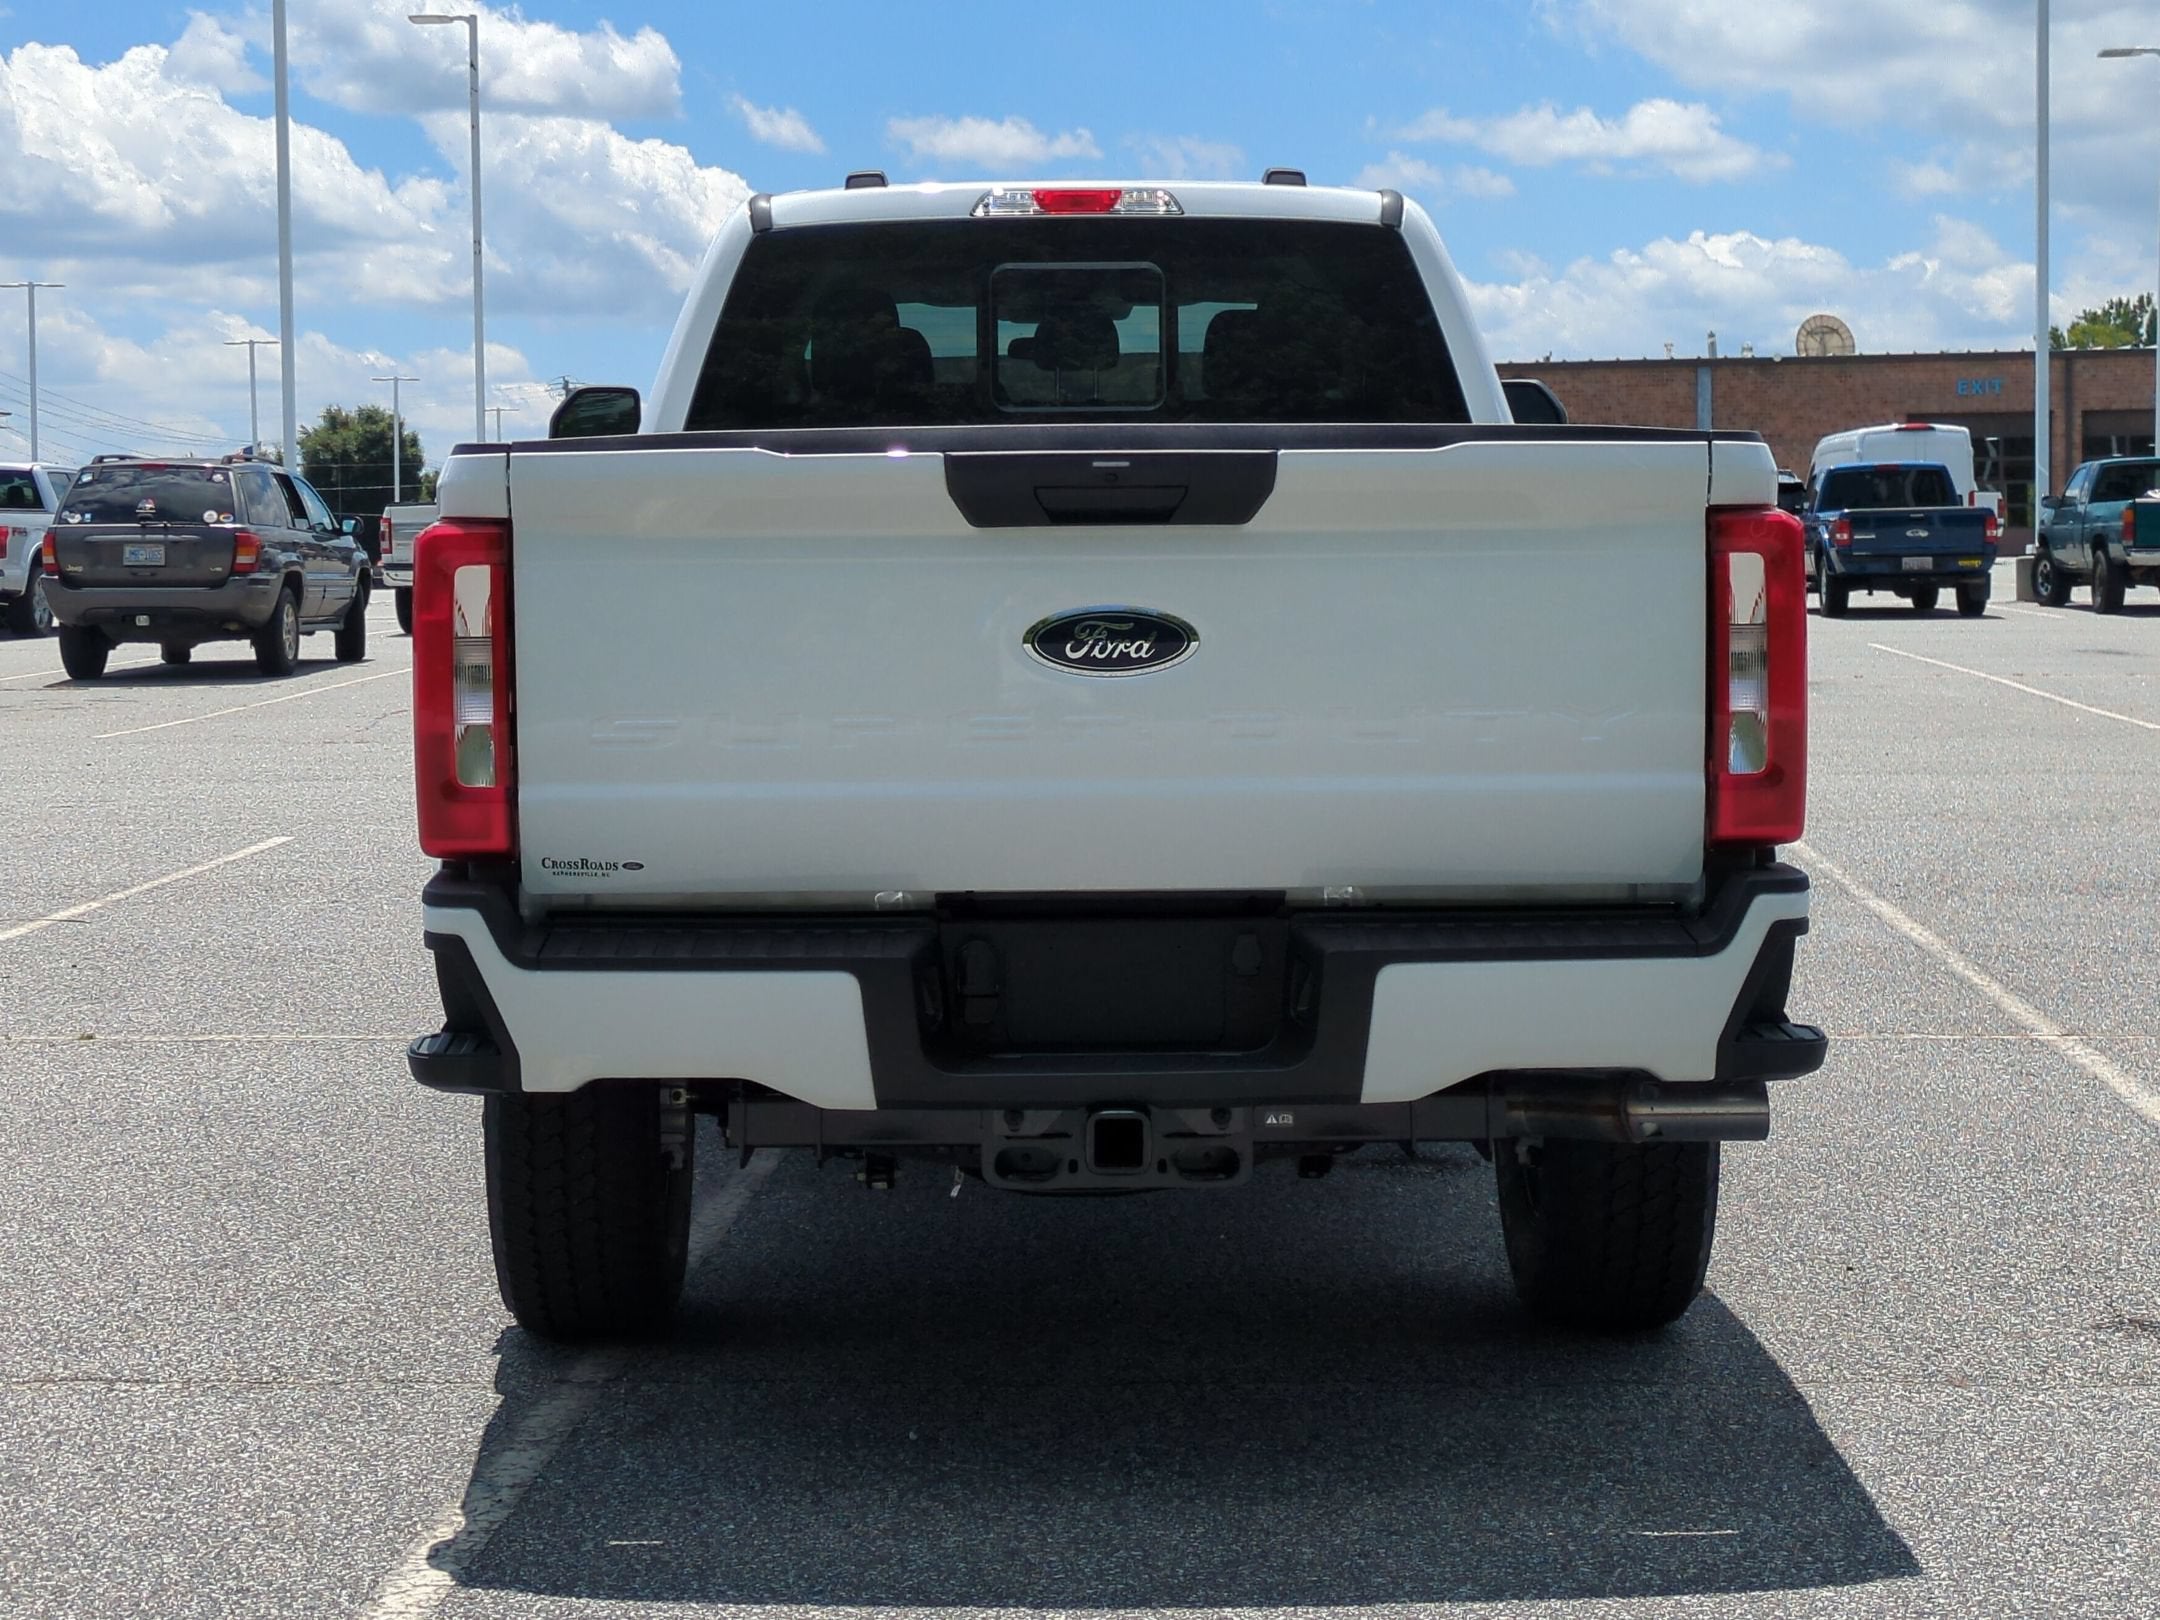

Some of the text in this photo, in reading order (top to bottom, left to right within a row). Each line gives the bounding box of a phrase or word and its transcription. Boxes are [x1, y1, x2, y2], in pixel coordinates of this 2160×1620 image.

[1957, 379, 2003, 395] EXIT
[1065, 620, 1158, 659] Ford
[591, 704, 1638, 751] SUPER DUTY
